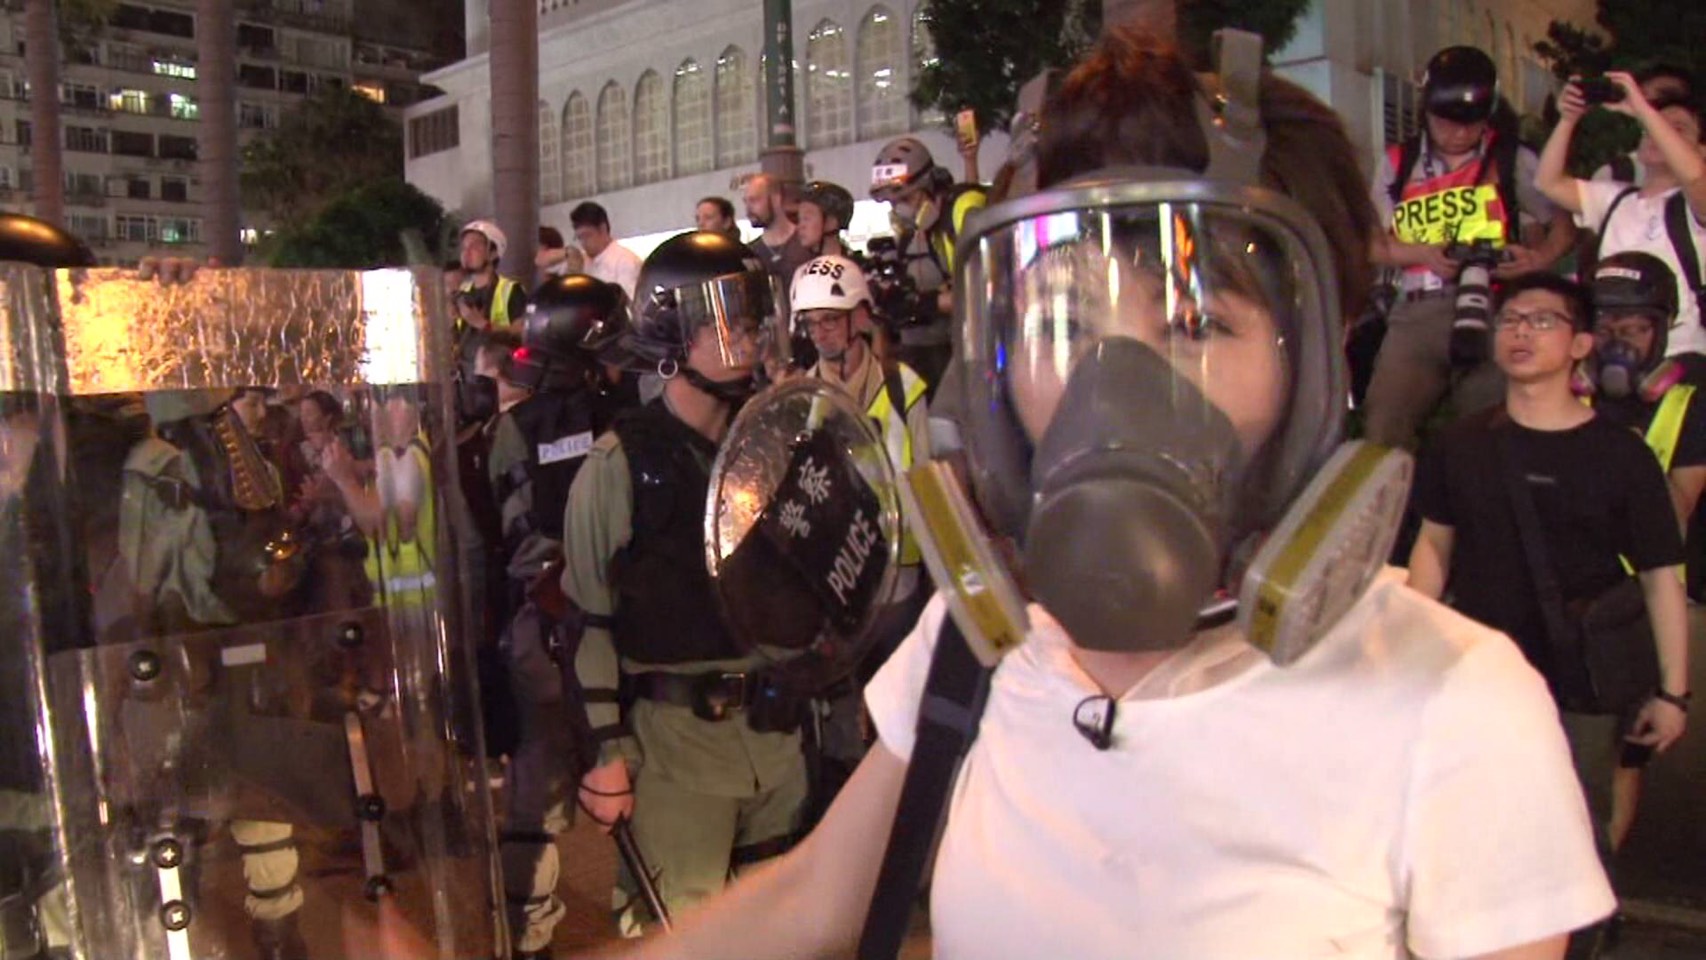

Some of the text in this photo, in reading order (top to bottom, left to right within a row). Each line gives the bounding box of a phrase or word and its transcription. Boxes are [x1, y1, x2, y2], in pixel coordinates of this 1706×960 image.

[1394, 188, 1477, 235] PRESS
[801, 260, 845, 280] ESS
[779, 456, 832, 538] 警察
[827, 509, 877, 605] POLICE
